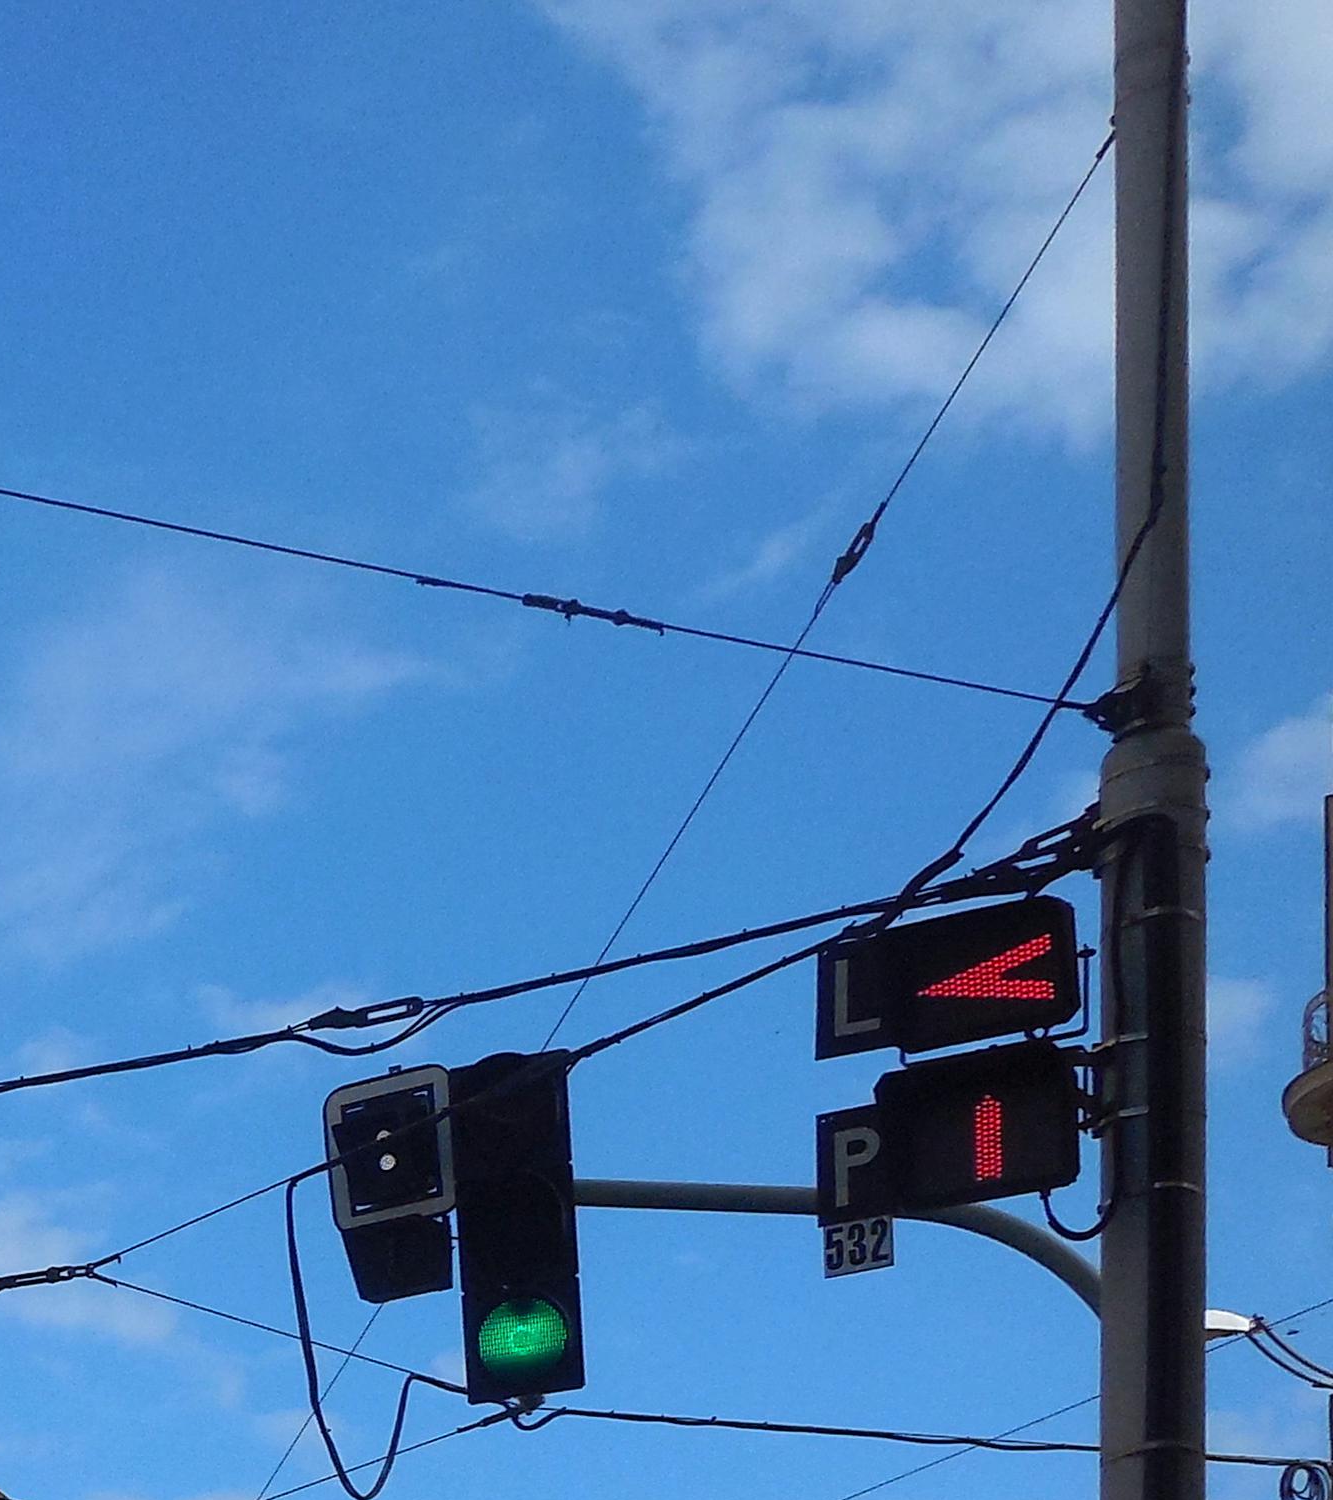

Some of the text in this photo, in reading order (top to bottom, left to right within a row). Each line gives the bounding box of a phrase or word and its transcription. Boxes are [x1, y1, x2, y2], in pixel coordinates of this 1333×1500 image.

[834, 958, 881, 1038] L
[834, 1126, 881, 1208] P
[825, 1217, 890, 1271] 532
